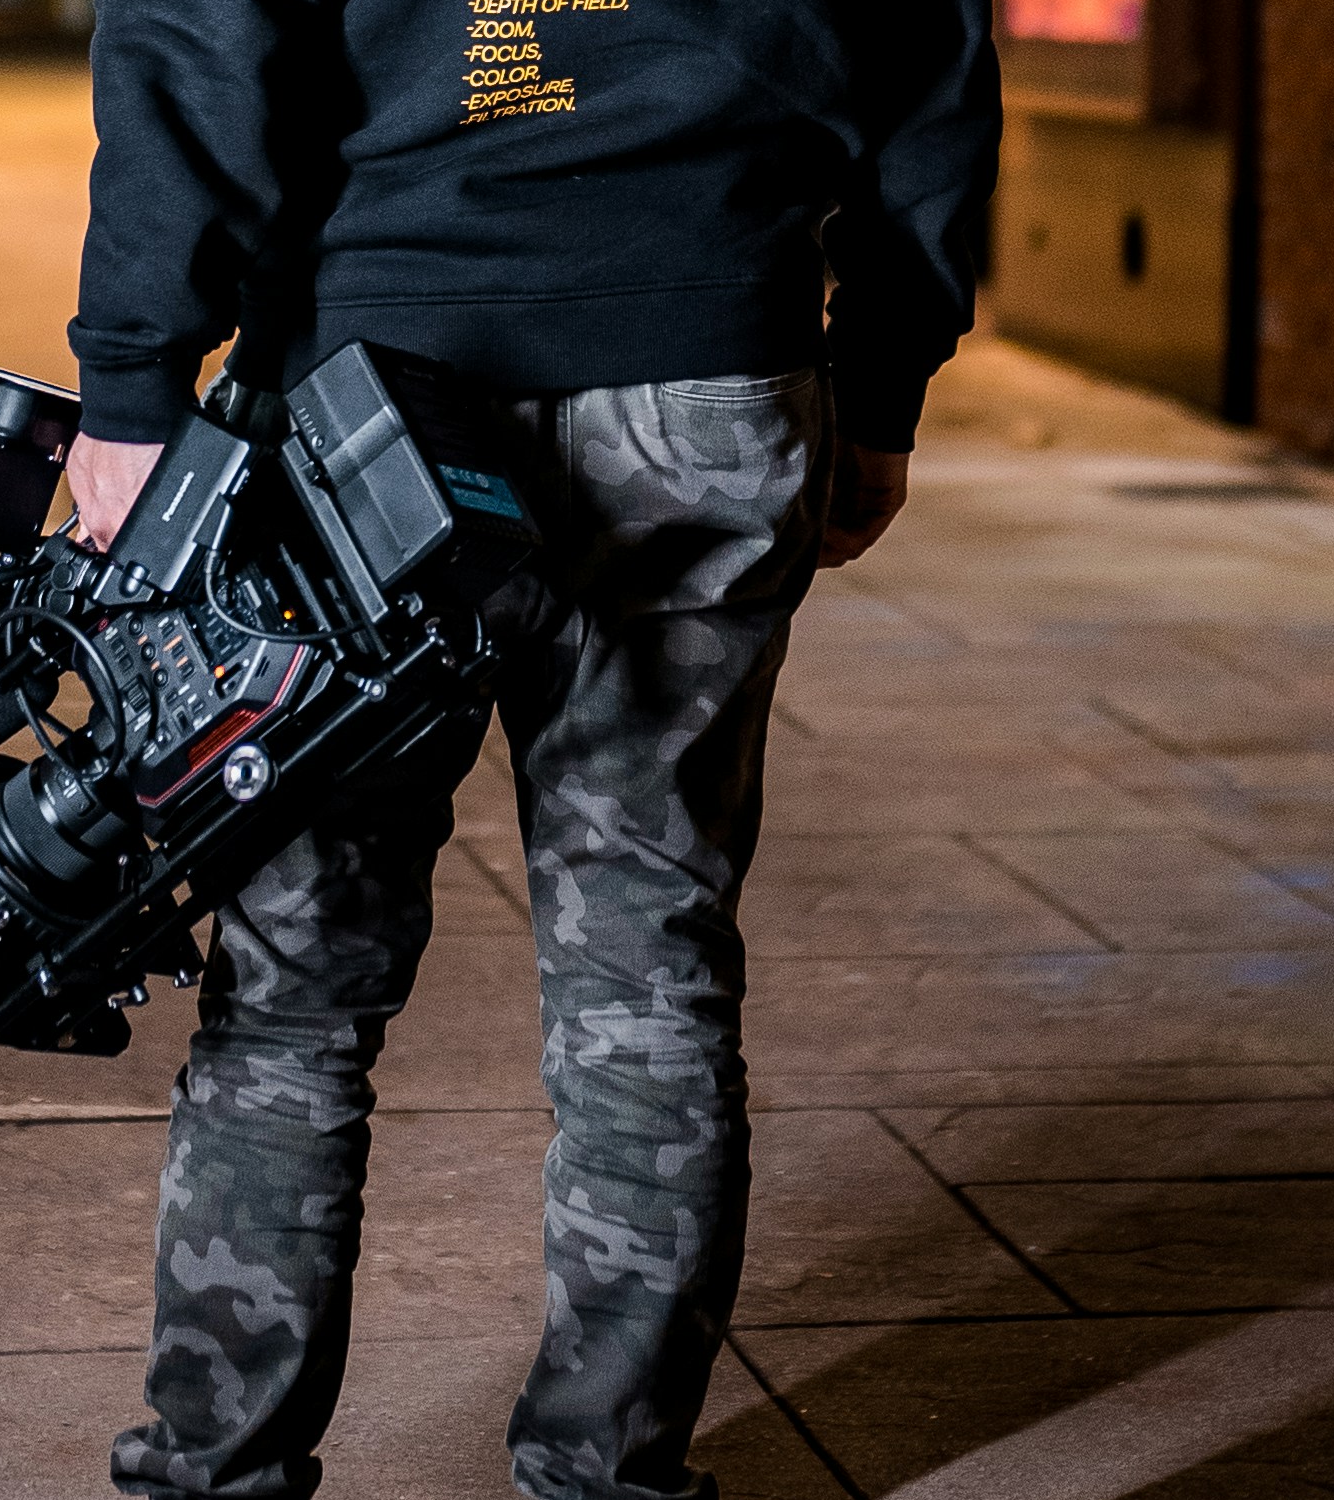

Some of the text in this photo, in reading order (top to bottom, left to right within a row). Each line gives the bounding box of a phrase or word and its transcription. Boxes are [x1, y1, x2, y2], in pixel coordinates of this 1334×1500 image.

[466, 20, 536, 39] -ZOOM,
[463, 43, 542, 62] -FOCUS,
[461, 65, 541, 87] -COLOR,
[460, 78, 575, 111] -EXPOSURE,
[459, 96, 576, 125] -FILTRATION.
